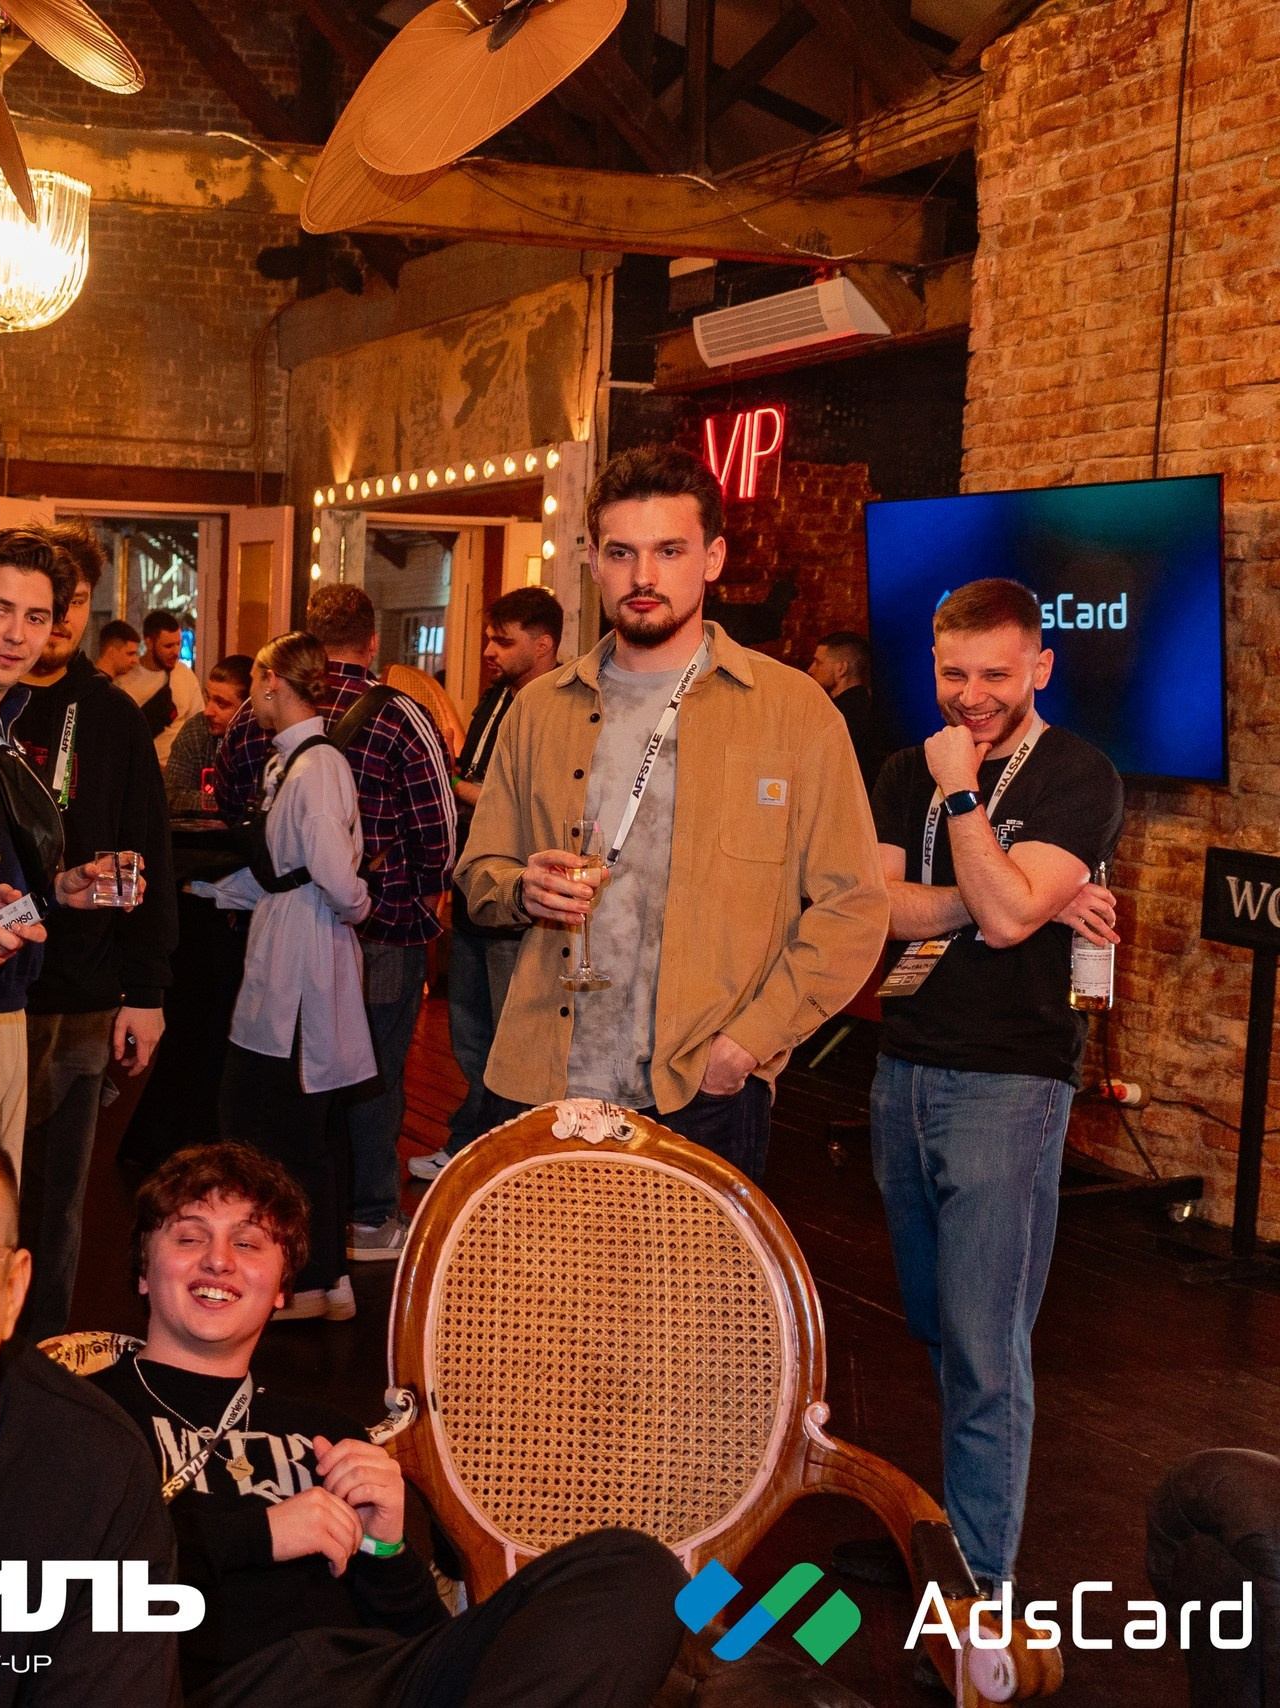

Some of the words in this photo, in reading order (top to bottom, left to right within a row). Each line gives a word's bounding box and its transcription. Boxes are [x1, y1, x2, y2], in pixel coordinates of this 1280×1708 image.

[705, 407, 783, 499] VIP
[1035, 592, 1127, 630] sCard
[674, 663, 697, 699] marlerino
[61, 707, 75, 754] AFFSTYLE
[632, 732, 663, 800] AFFSTYLE
[993, 742, 1030, 798] AFFSTYLE
[923, 806, 939, 867] AFFSTYLE
[226, 1393, 248, 1427] marlerino
